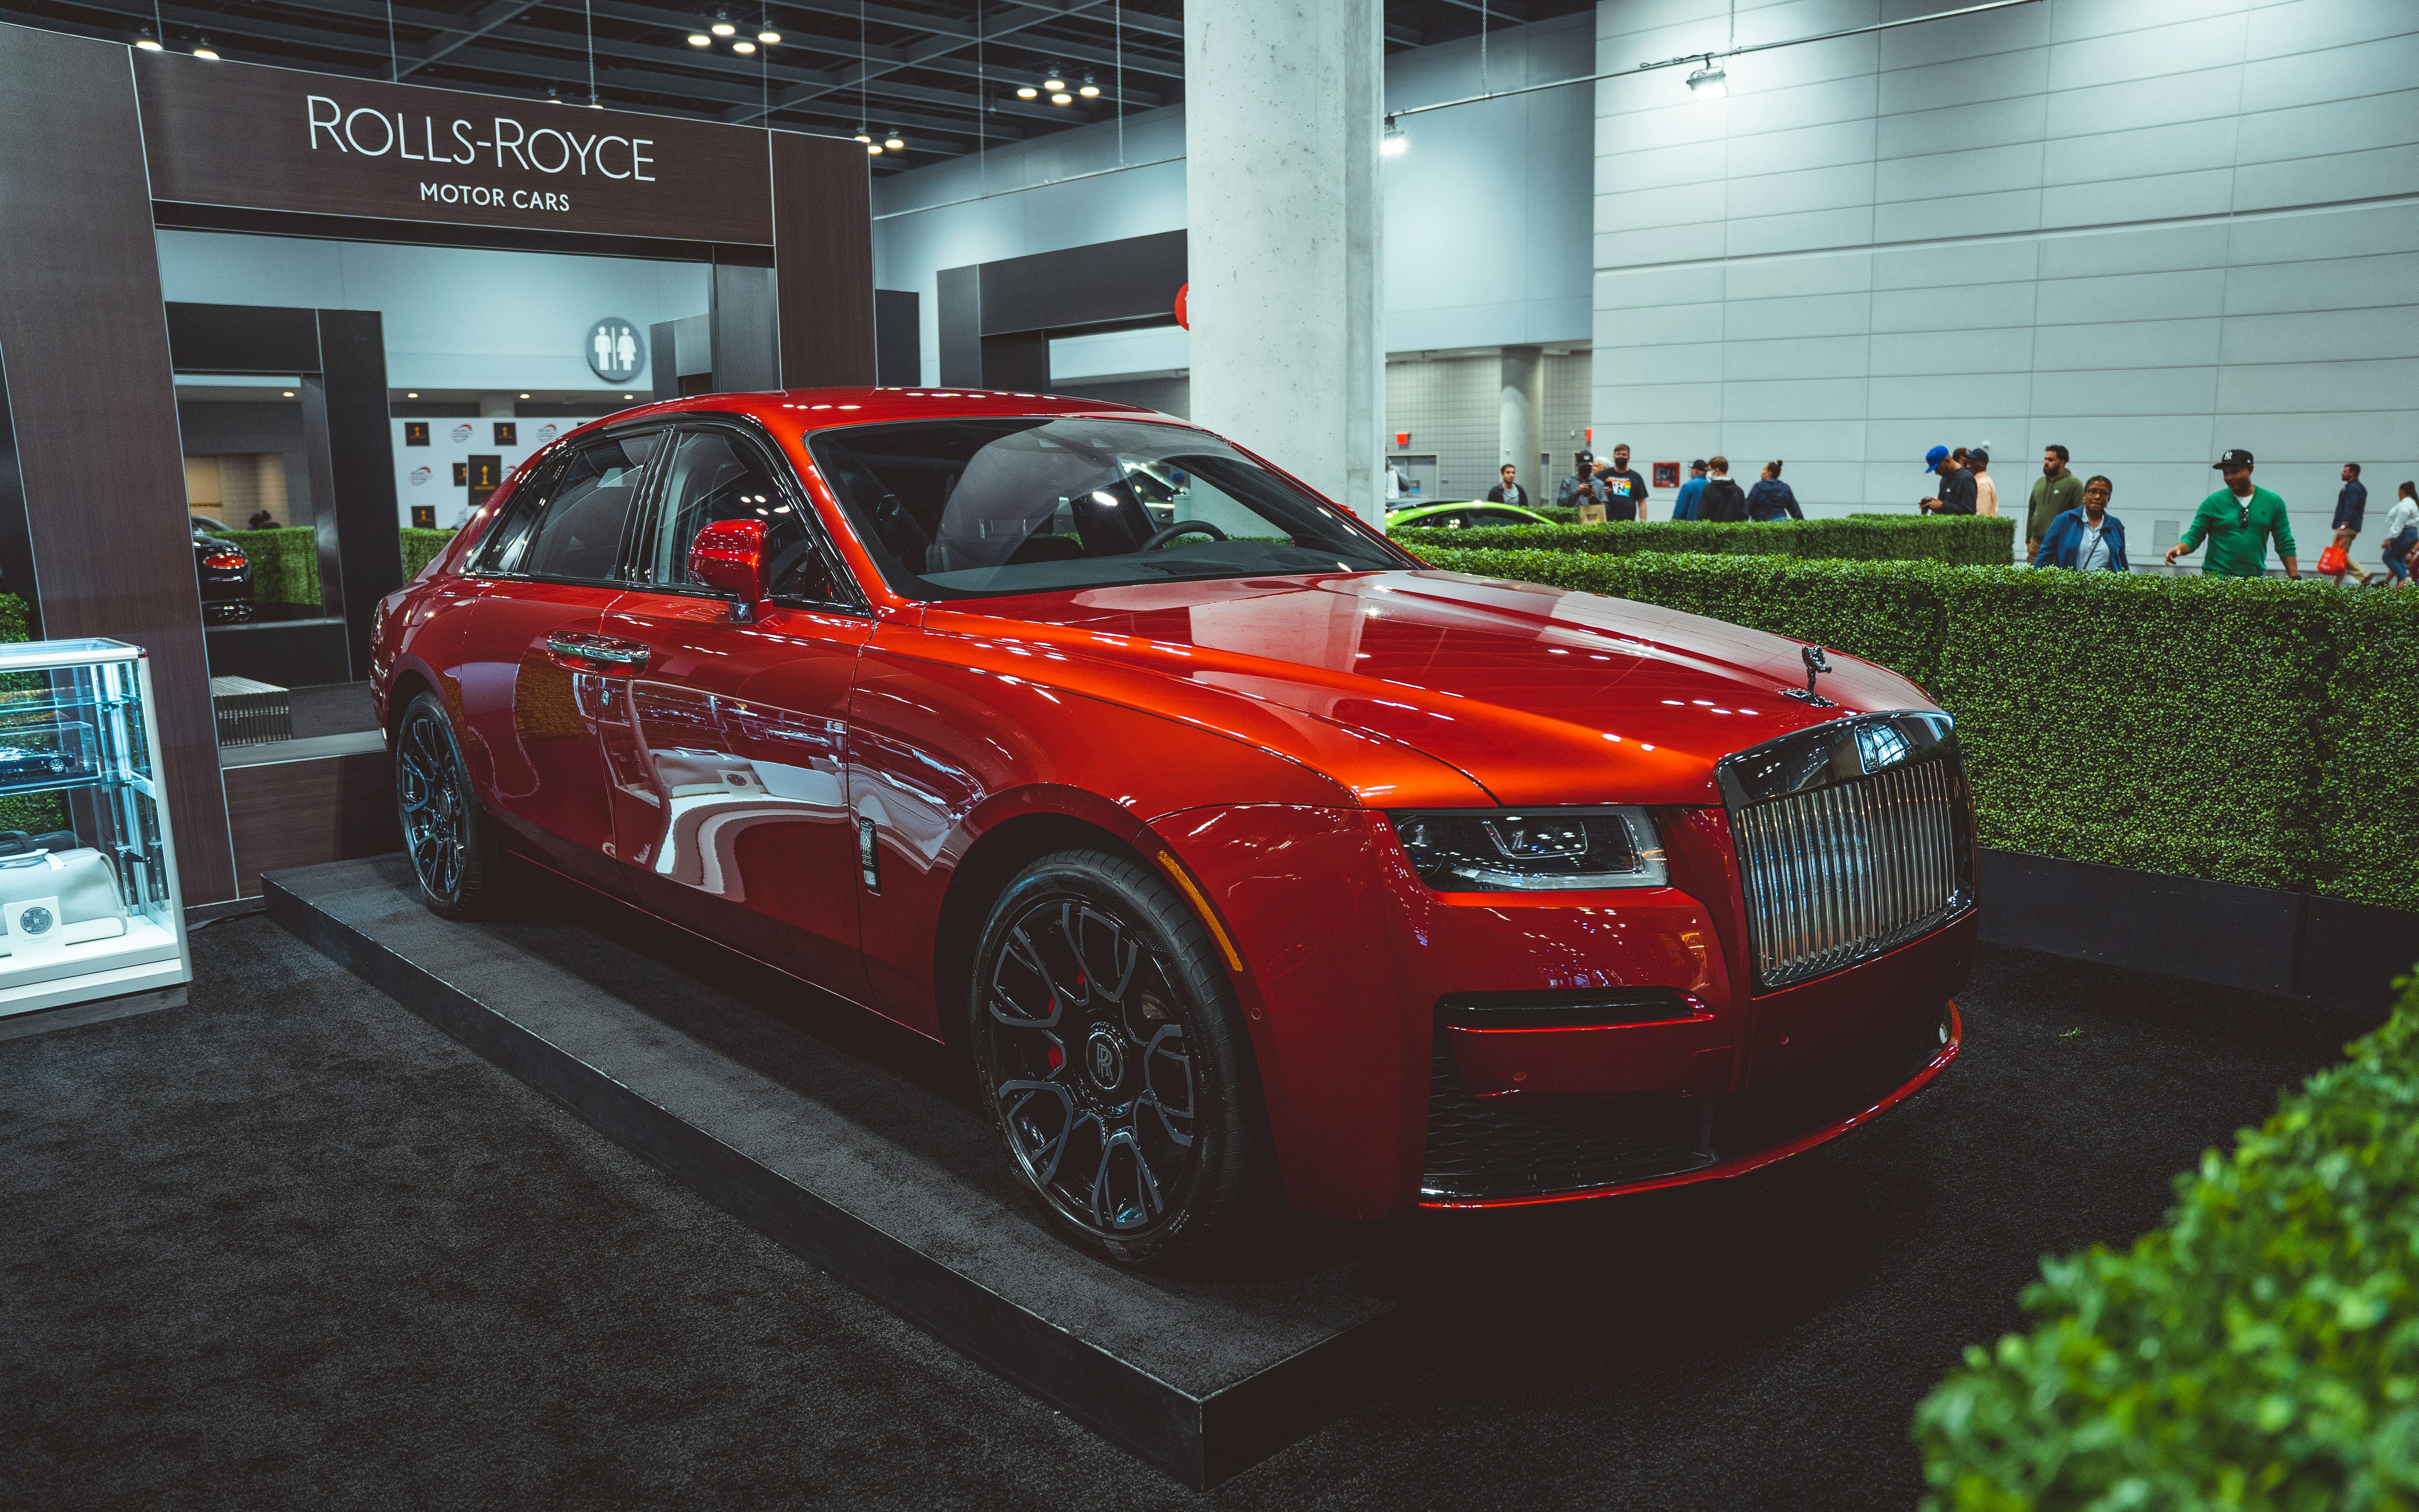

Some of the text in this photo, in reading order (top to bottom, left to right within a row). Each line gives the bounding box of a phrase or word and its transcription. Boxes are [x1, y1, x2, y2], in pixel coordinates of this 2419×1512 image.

[307, 95, 655, 181] ROLLS-ROYCE
[421, 182, 569, 211] MOTOR CARS
[1097, 1043, 1114, 1081] RR
